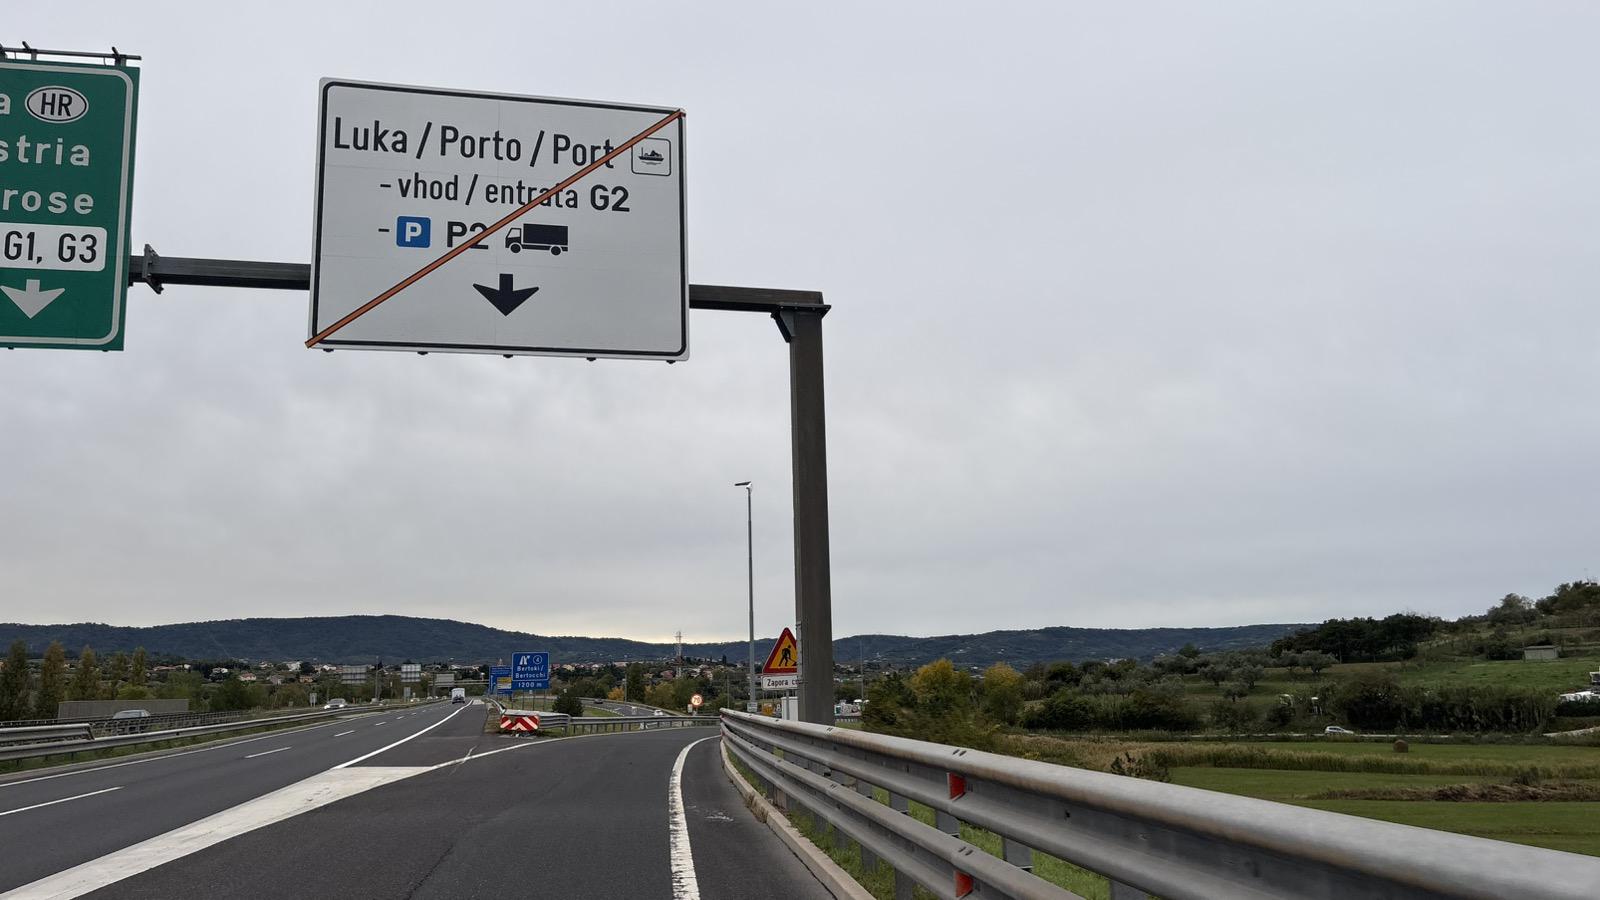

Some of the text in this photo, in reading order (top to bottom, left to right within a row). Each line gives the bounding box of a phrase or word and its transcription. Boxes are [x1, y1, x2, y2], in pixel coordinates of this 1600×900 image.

[40, 92, 73, 117] HR
[334, 117, 408, 153] Luka
[440, 125, 522, 162] Porto
[553, 133, 615, 169] Port
[2, 188, 95, 215] rose
[398, 172, 458, 201] vhod
[485, 180, 579, 209] entrata
[590, 184, 630, 213] G2
[4, 230, 98, 265] G1, G3
[446, 221, 489, 250] P2
[767, 678, 789, 687] Zapora
